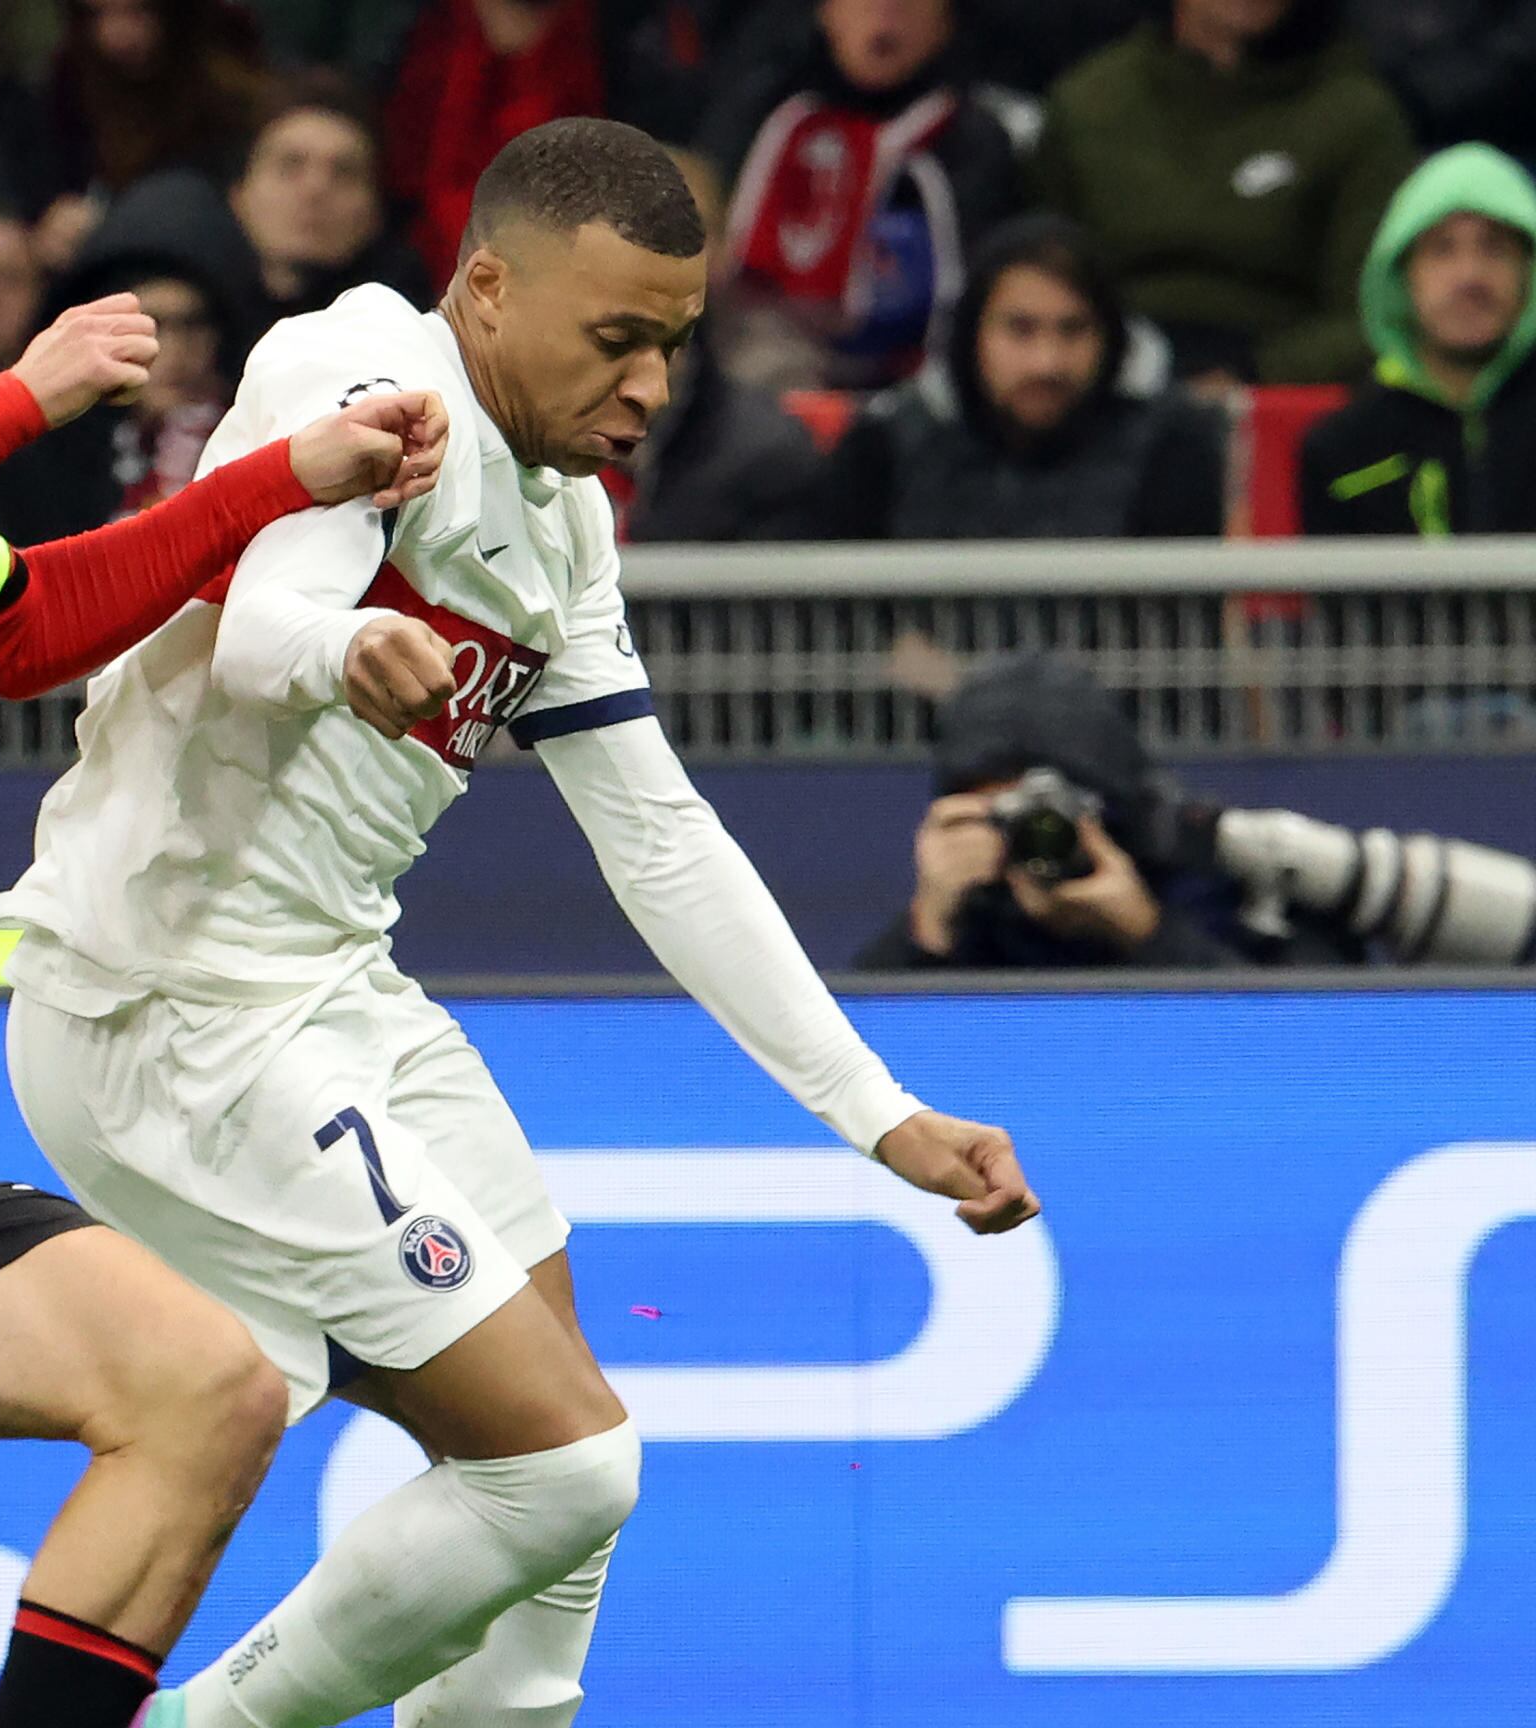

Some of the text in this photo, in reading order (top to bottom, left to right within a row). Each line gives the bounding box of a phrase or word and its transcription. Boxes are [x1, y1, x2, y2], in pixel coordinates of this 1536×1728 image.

[313, 1105, 418, 1227] 7
[404, 1219, 443, 1252] PARIS
[227, 1622, 280, 1686] PARIS
